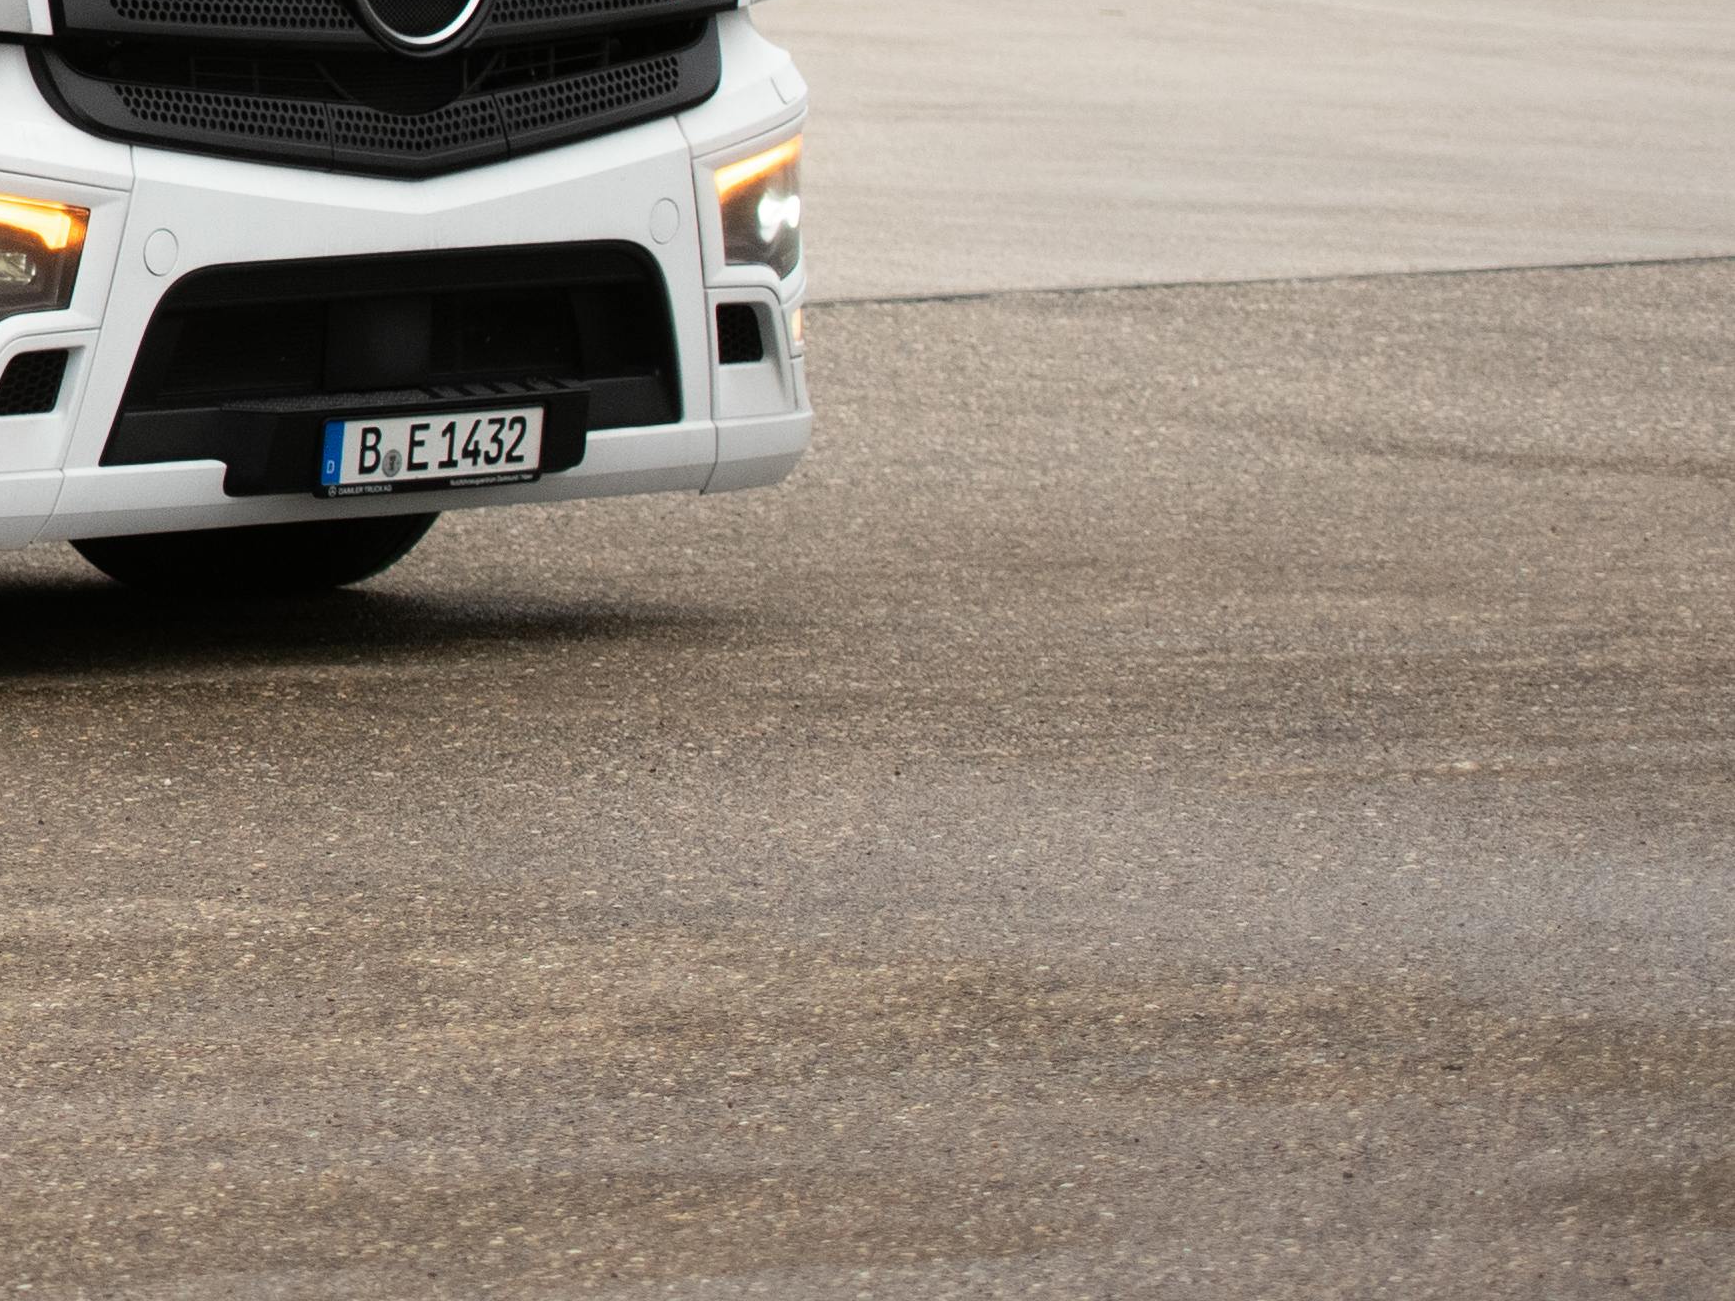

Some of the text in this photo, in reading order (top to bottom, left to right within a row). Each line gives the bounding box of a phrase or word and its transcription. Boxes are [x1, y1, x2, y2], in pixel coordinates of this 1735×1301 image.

[327, 415, 527, 475] D B E 1432
